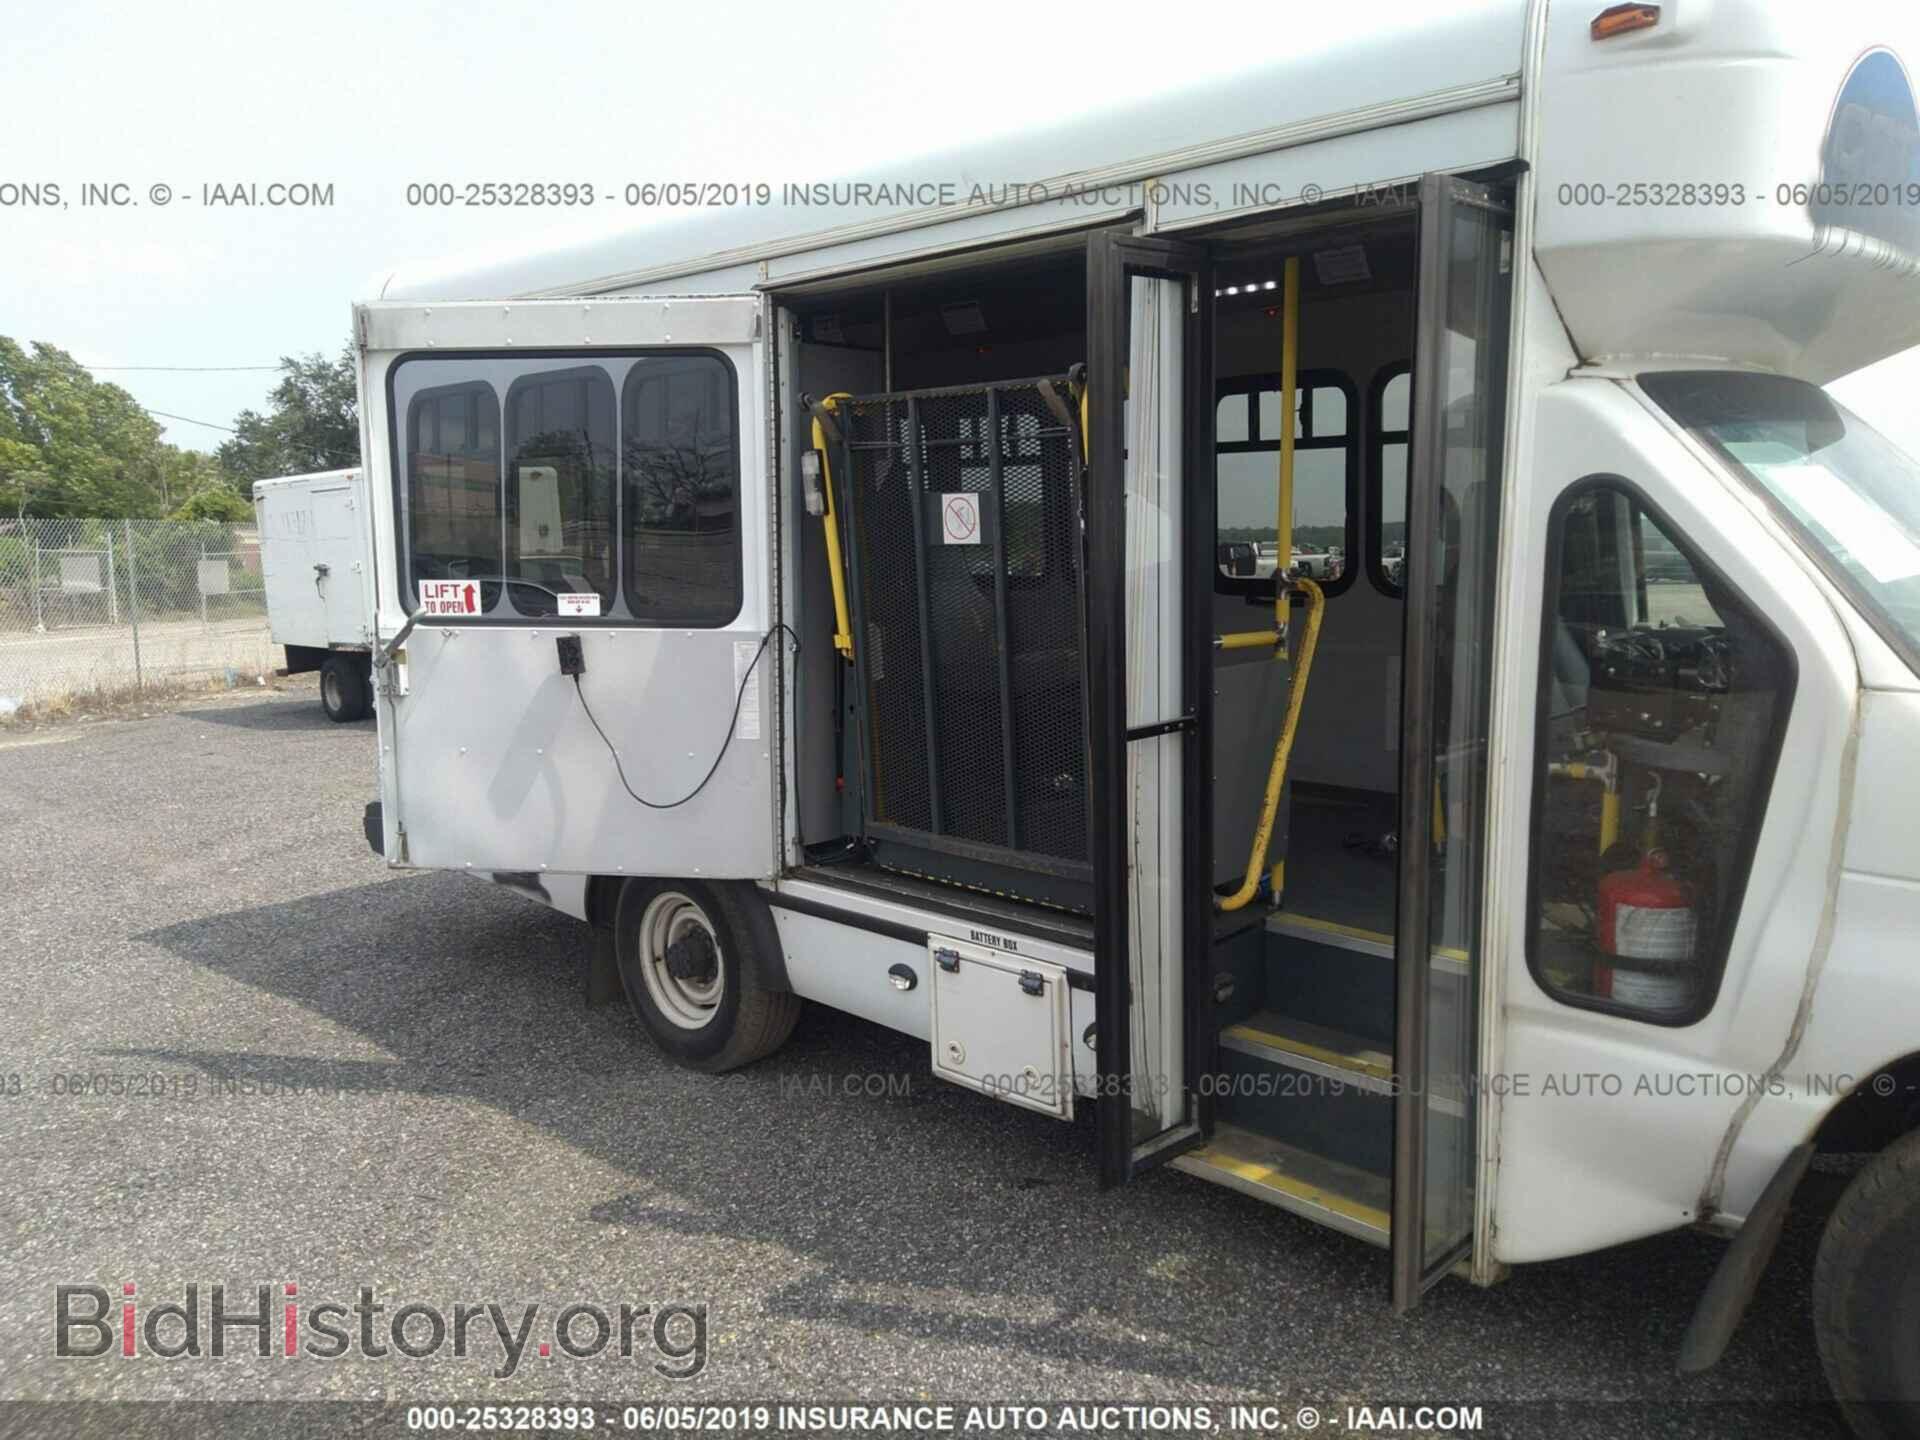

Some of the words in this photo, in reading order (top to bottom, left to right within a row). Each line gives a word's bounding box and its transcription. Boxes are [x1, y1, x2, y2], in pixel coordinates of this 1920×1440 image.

[424, 583, 461, 598] LIFT
[424, 601, 437, 613] TO
[440, 601, 465, 613] OPEN
[970, 929, 1001, 946] BATTERY
[1003, 937, 1018, 951] BOX
